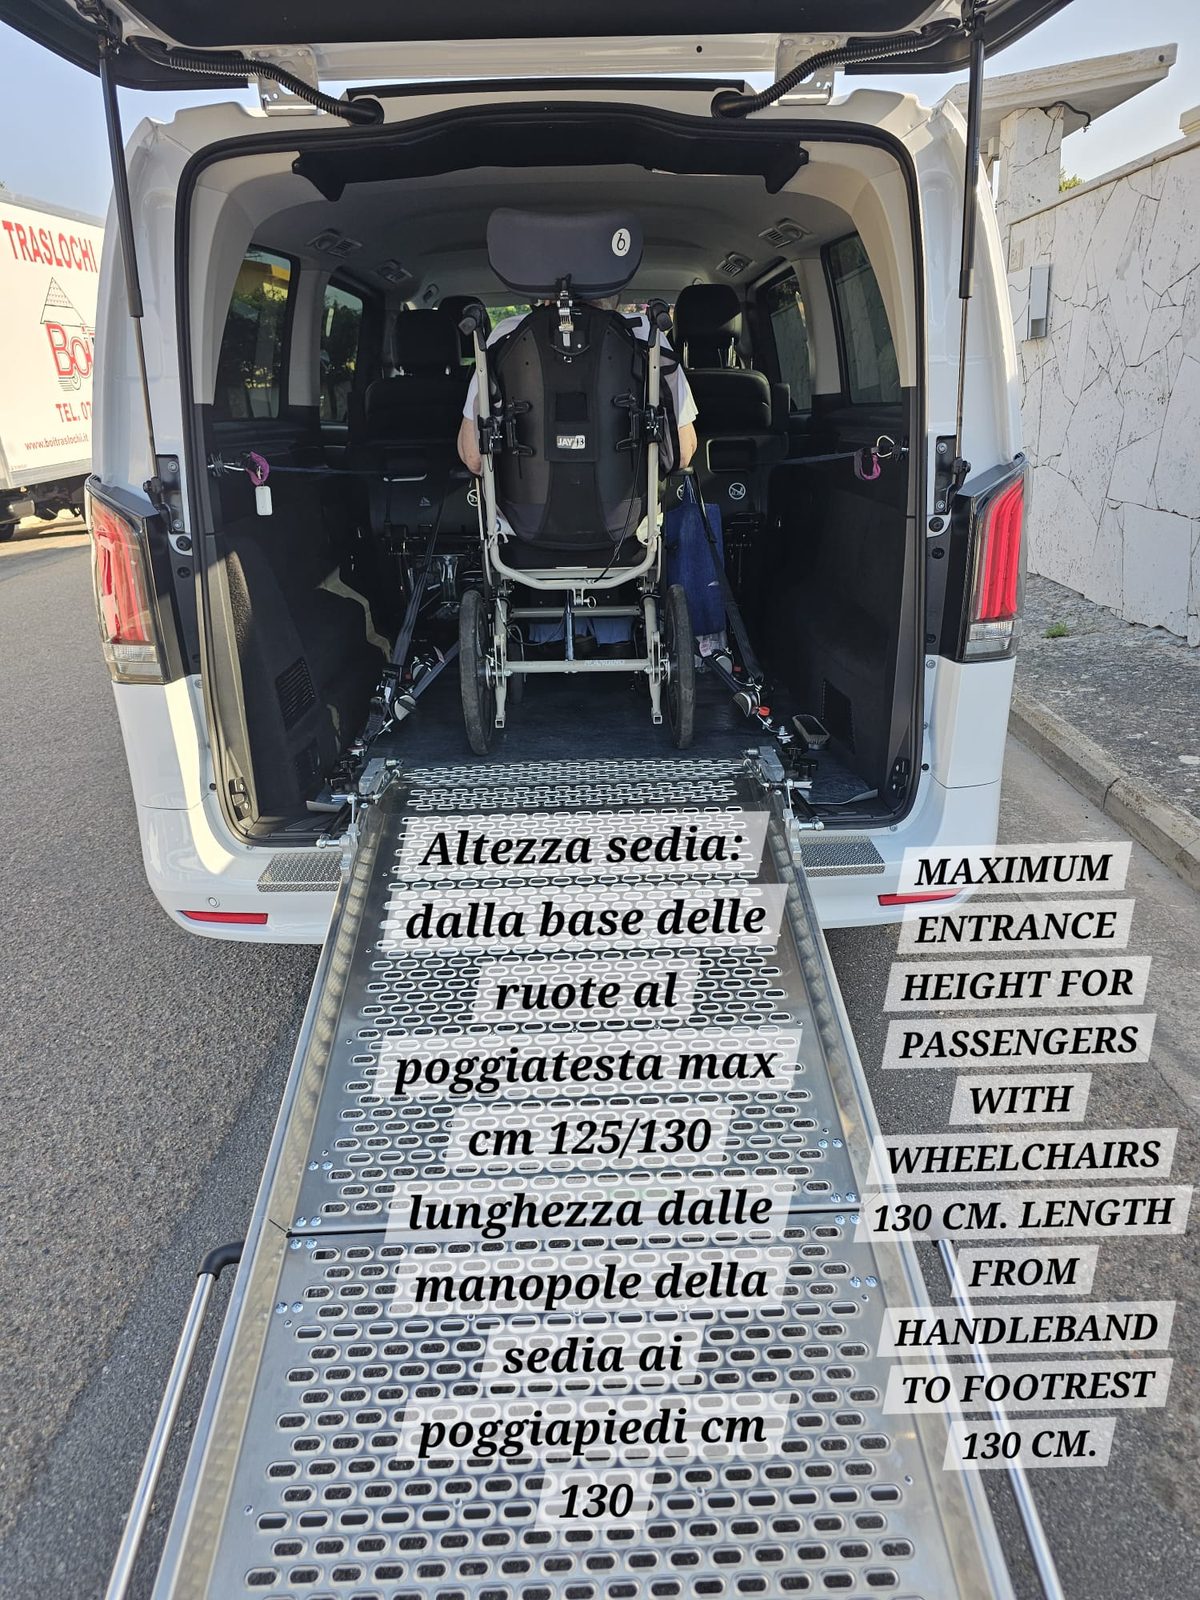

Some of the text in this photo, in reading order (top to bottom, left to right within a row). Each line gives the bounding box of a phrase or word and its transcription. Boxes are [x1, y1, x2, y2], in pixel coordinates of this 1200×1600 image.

[2, 220, 98, 273] TRASLOCHI
[55, 402, 81, 423] TEL.
[557, 437, 573, 447] JAY
